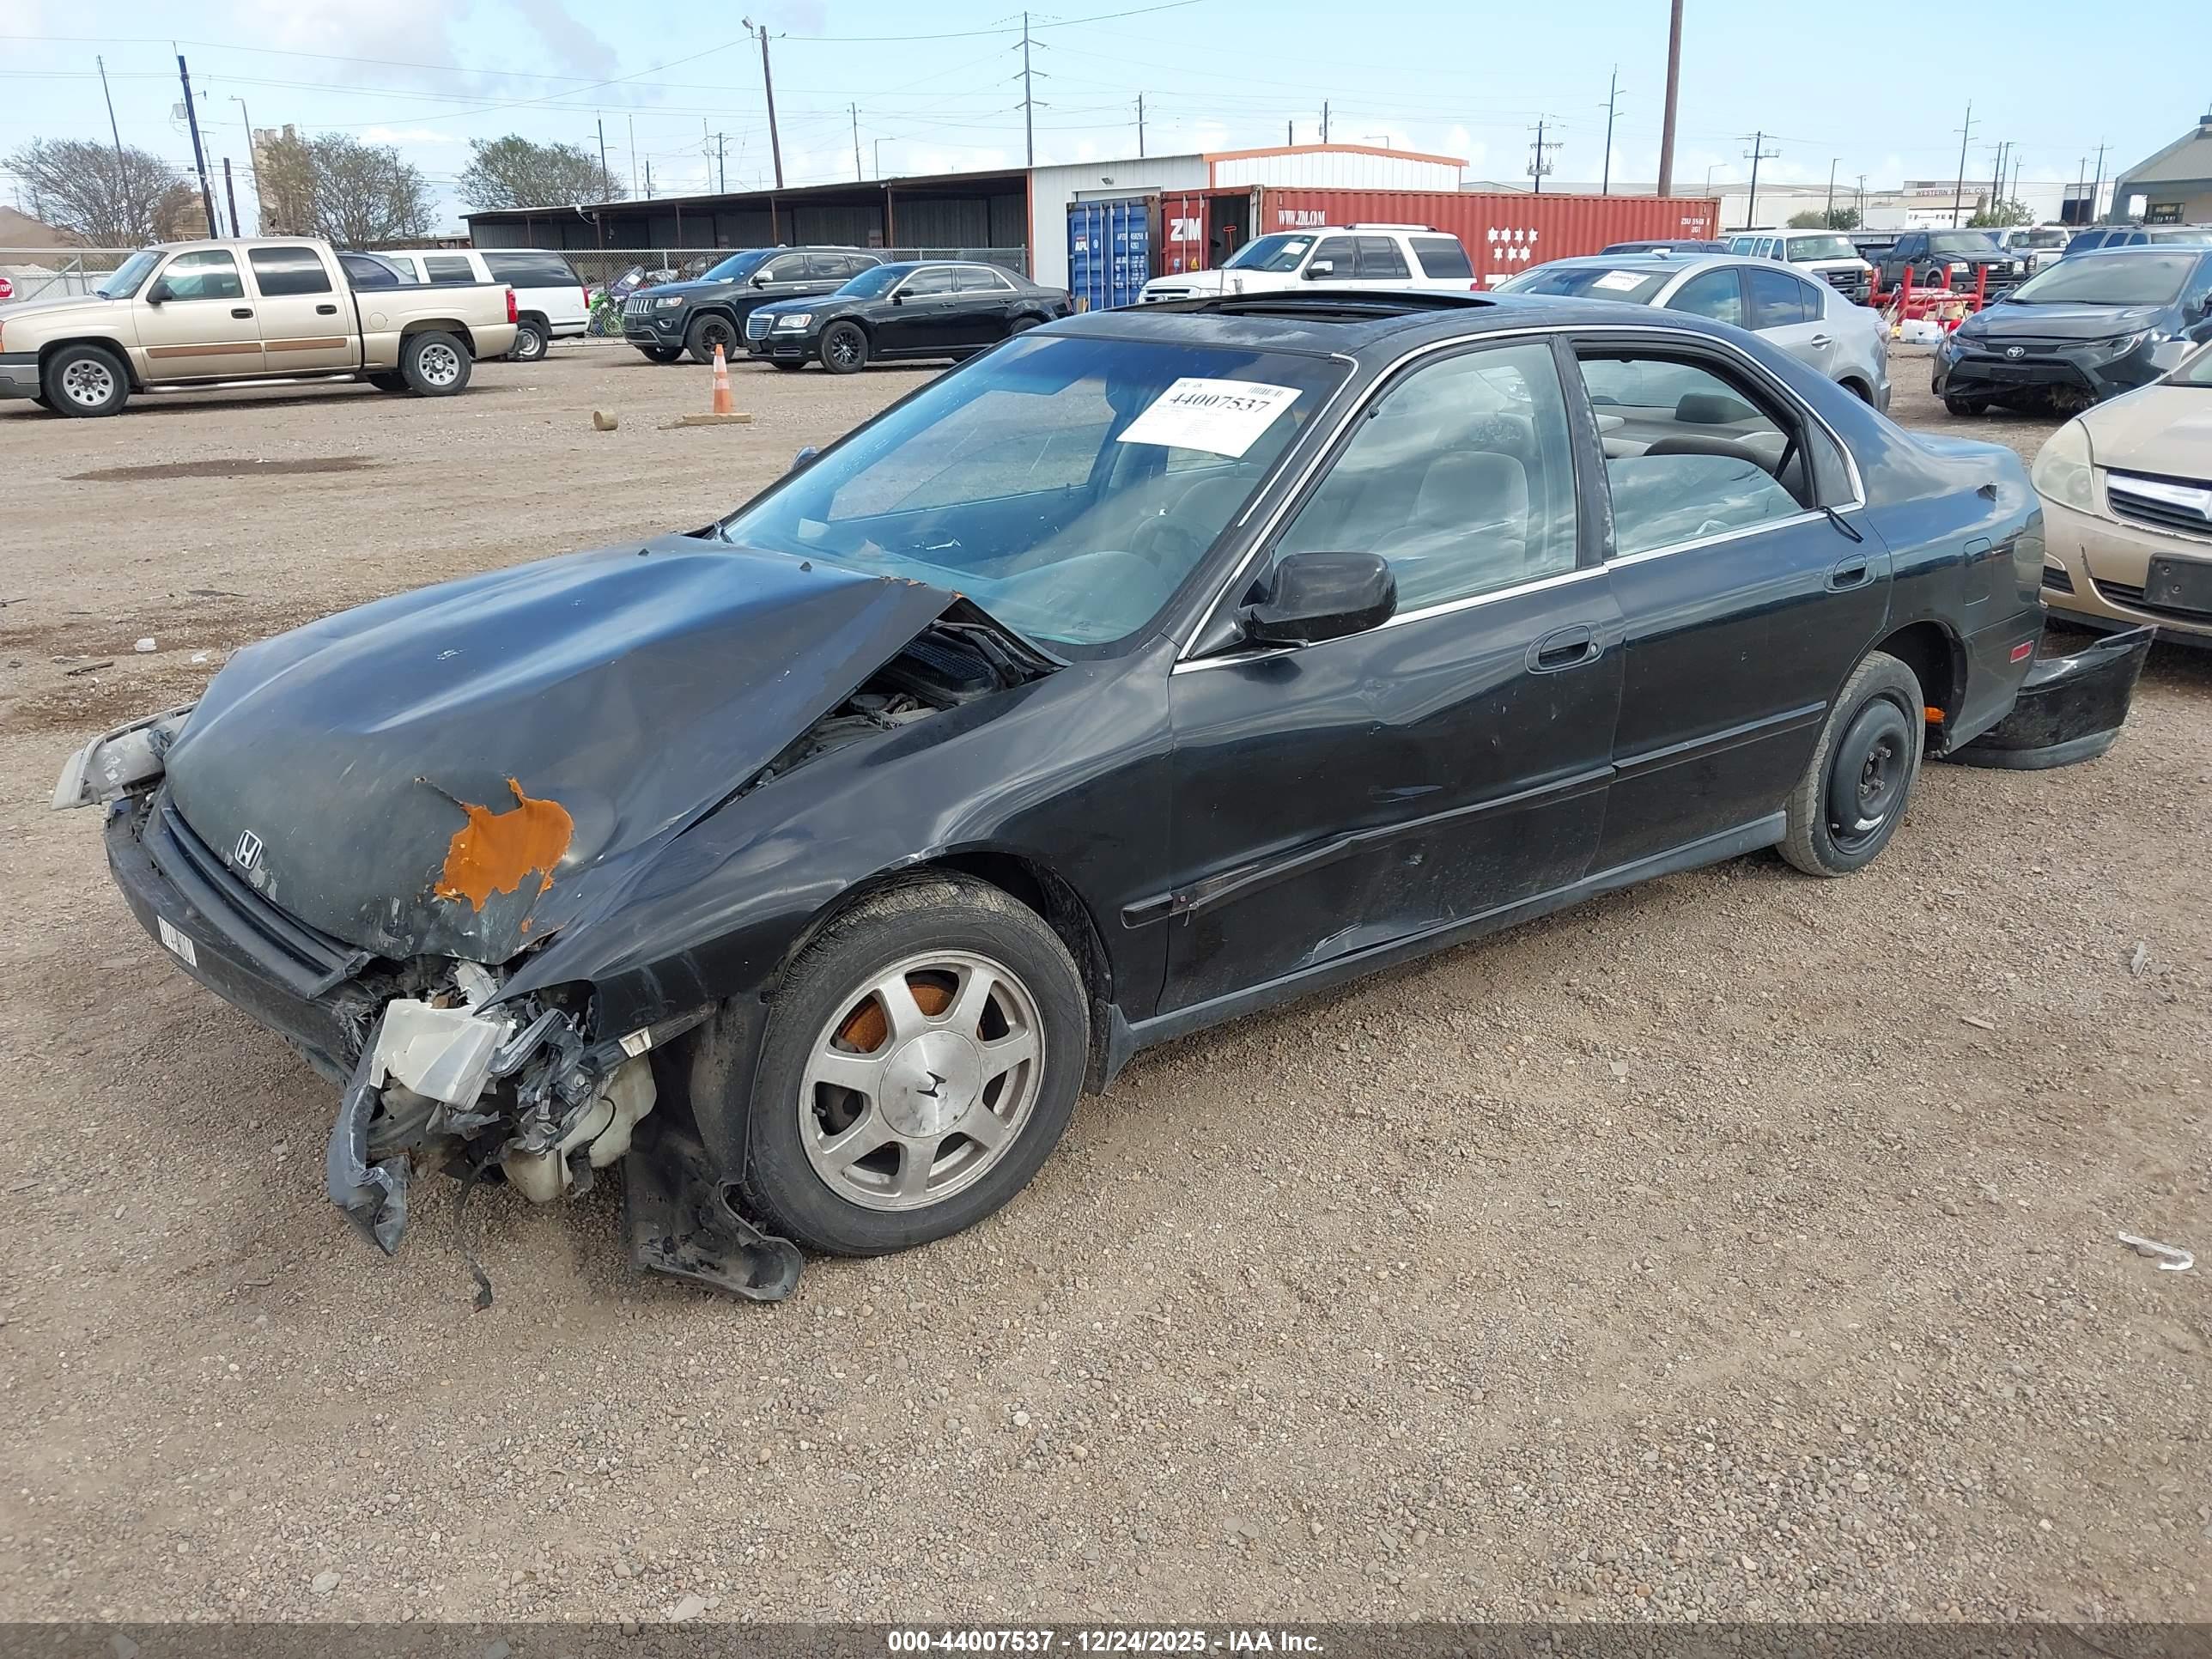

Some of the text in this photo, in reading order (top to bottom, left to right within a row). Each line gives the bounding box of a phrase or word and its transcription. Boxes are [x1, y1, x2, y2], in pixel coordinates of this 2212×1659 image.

[1916, 189, 1948, 198] WESTERN
[1170, 217, 1202, 242] ZIM
[1170, 392, 1271, 413] 44007537
